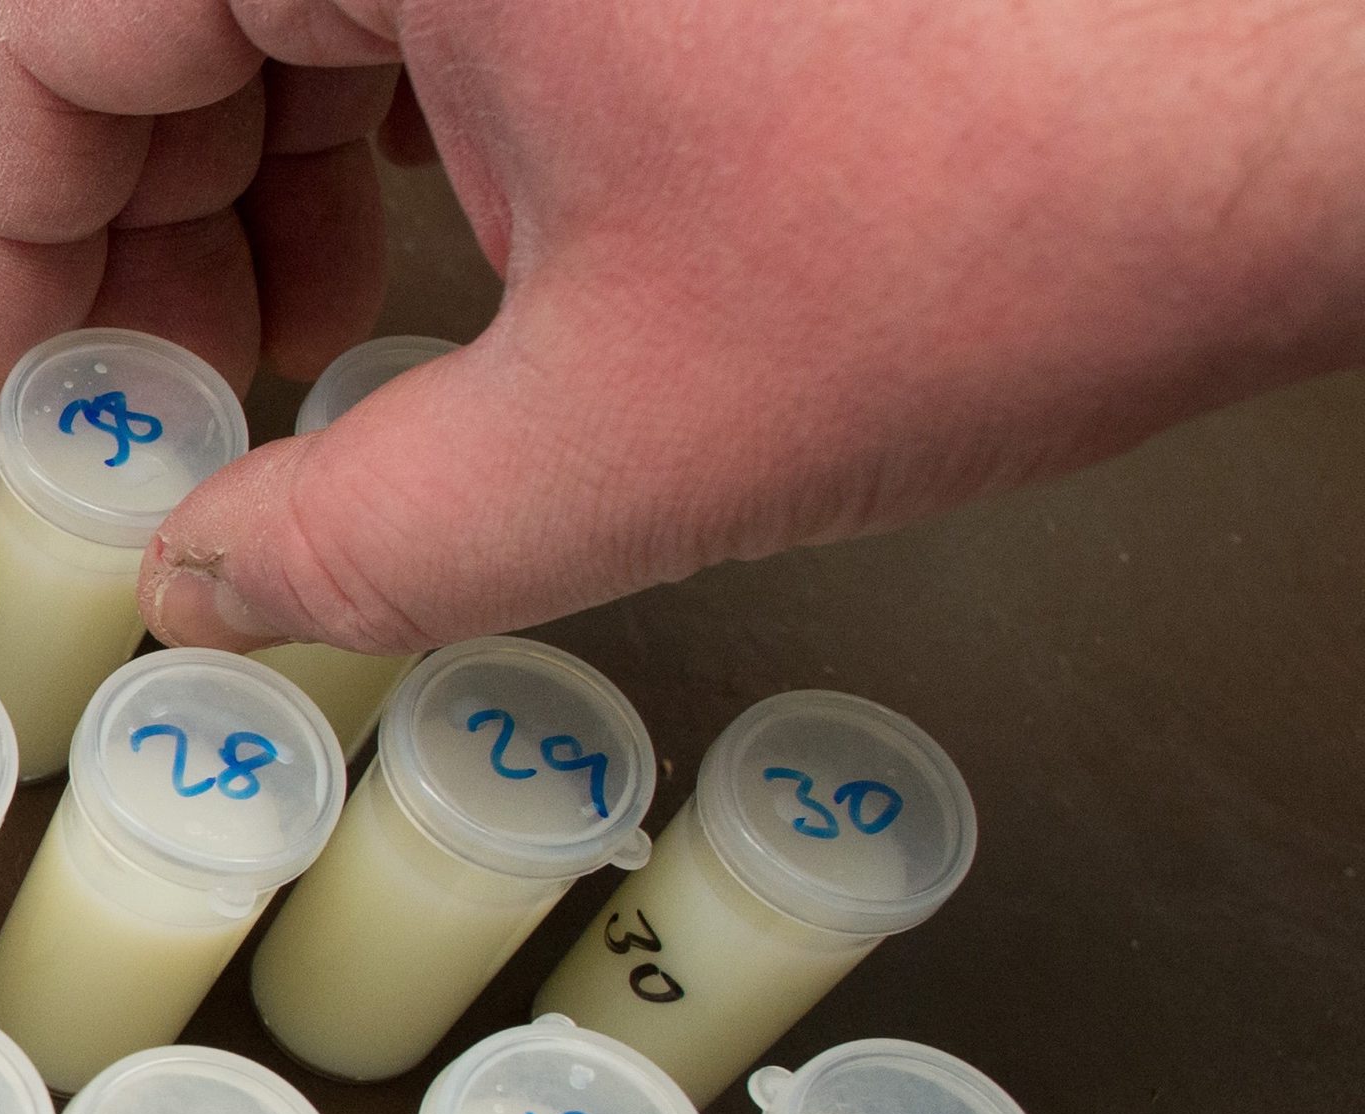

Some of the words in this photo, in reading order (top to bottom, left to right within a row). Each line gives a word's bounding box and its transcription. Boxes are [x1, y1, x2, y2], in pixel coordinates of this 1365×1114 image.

[129, 723, 282, 801] 28
[467, 709, 610, 820] 29
[764, 767, 903, 840] 30
[604, 909, 685, 1004] 30
